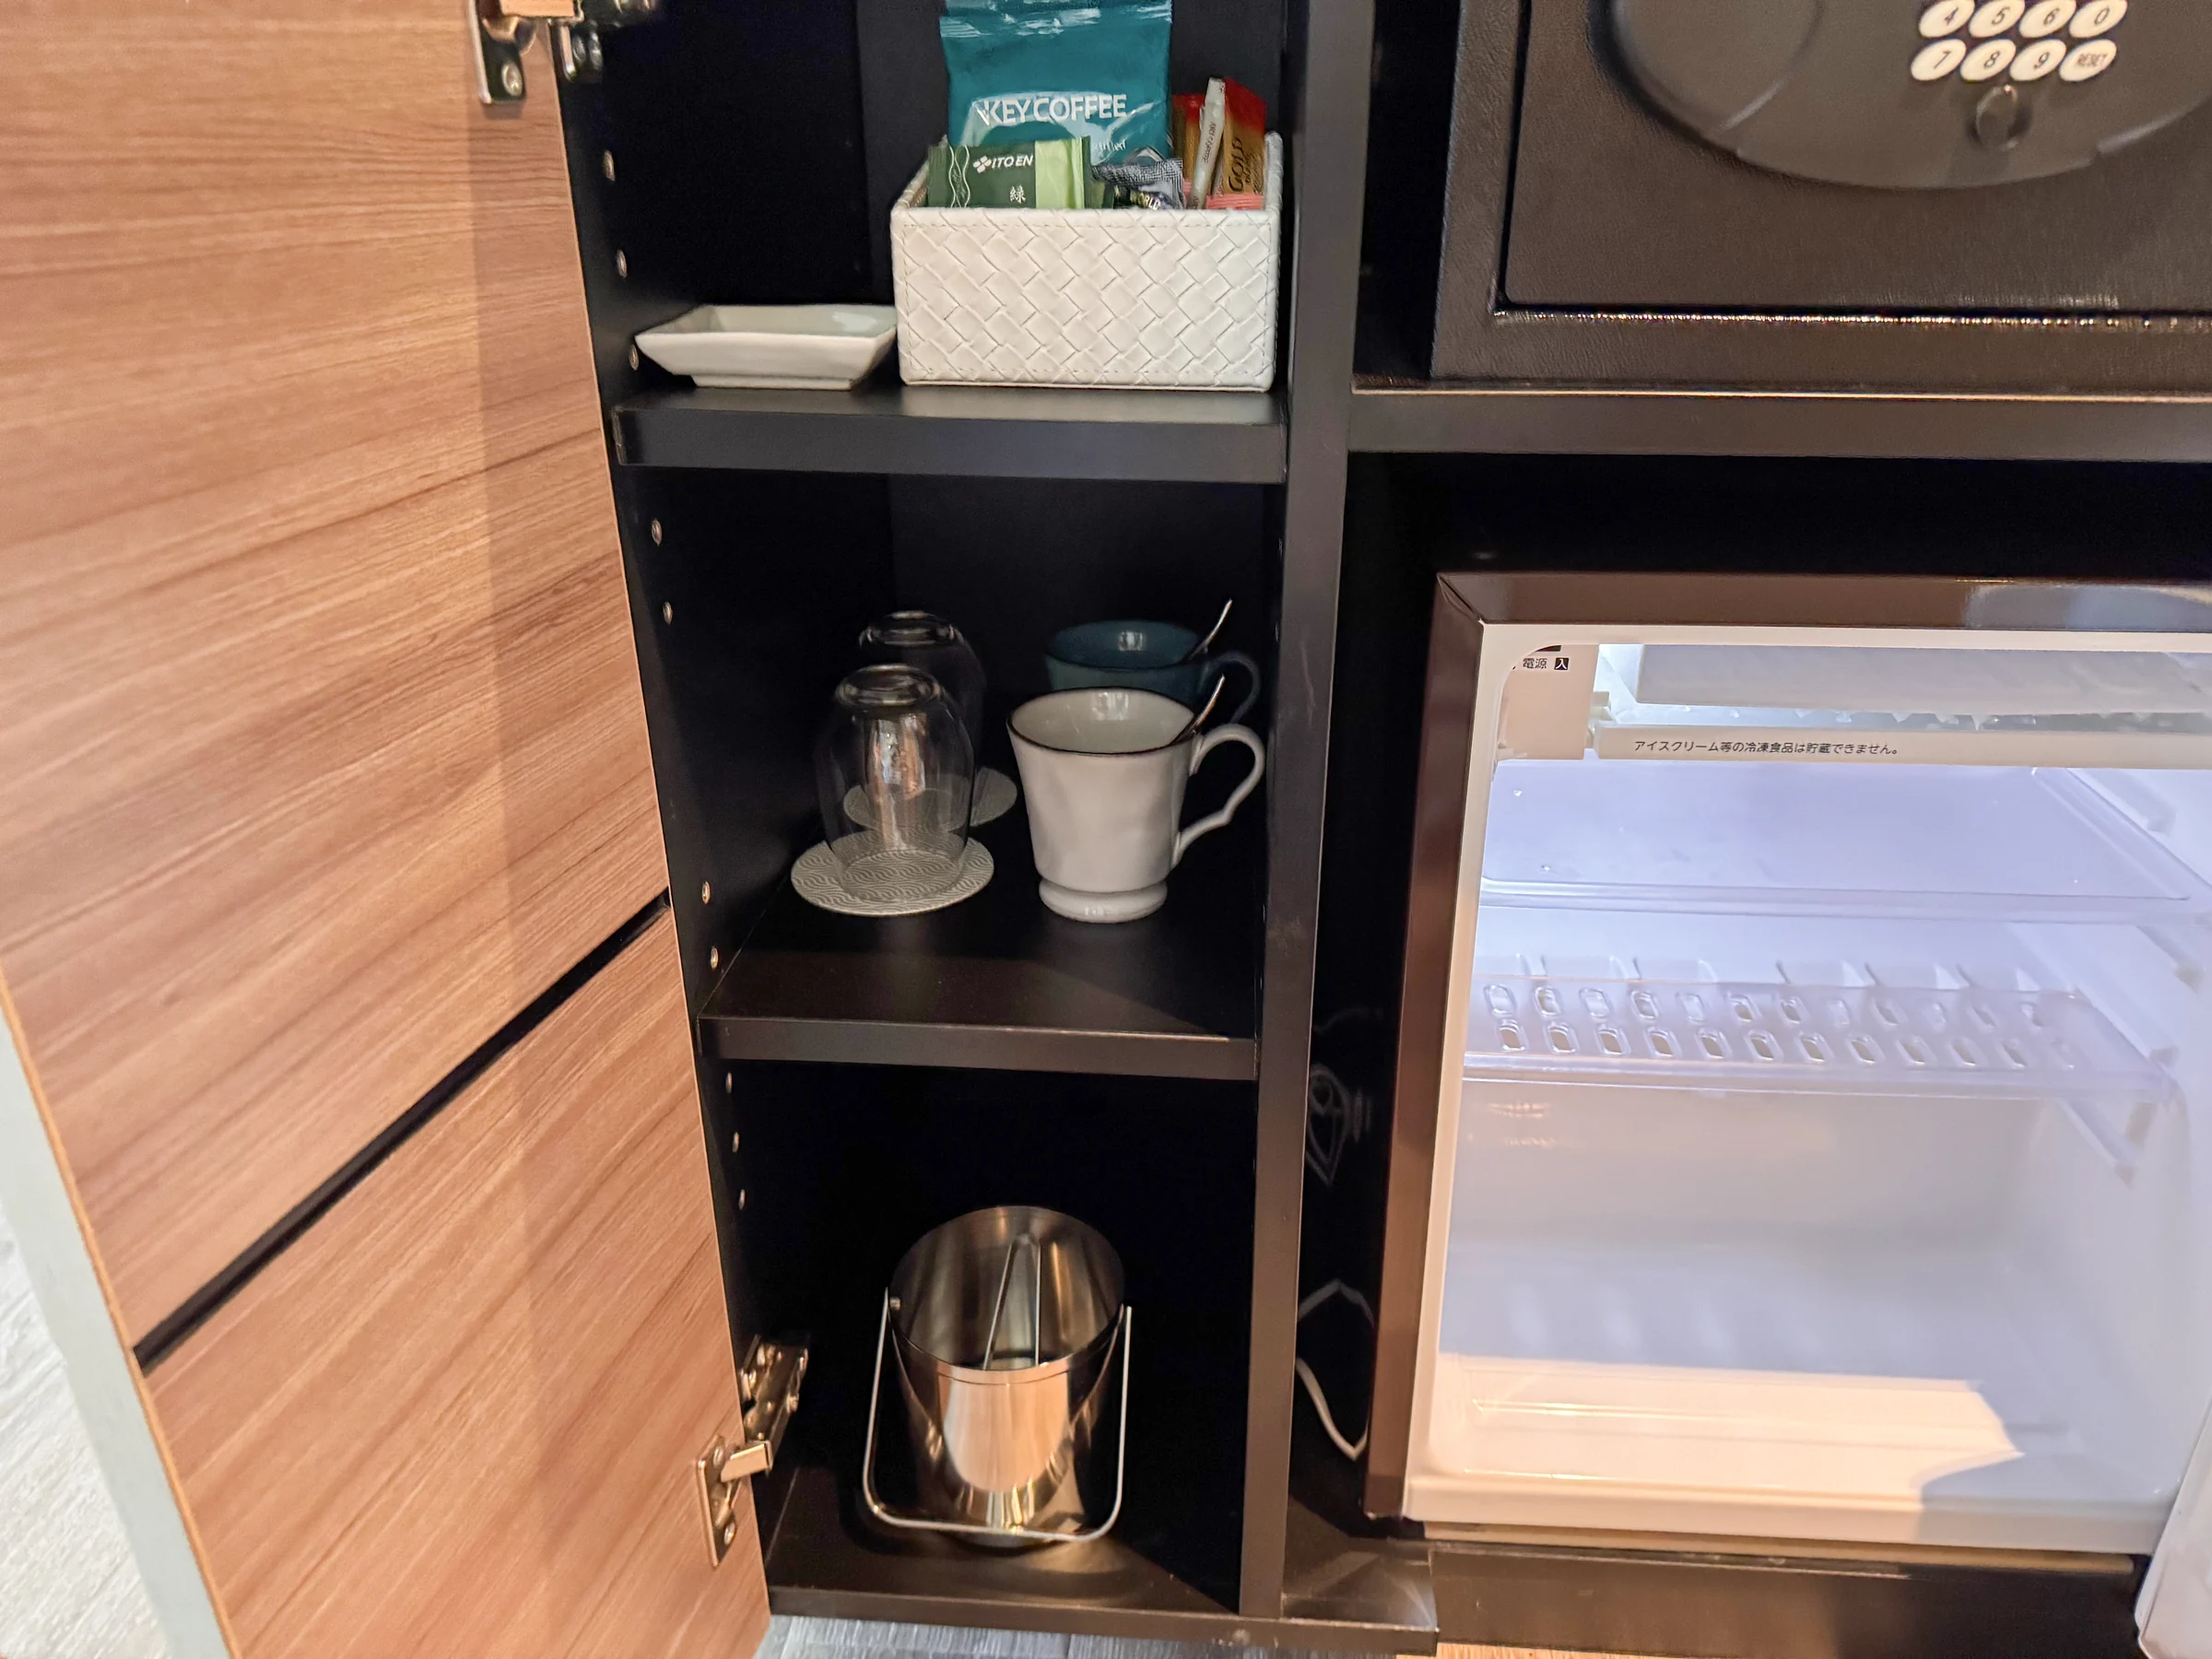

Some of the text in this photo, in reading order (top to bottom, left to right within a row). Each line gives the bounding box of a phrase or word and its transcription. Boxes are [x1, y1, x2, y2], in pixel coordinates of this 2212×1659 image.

[1943, 7, 1959, 26] 4
[1991, 6, 2010, 26] 5
[2042, 7, 2061, 26] 6
[1933, 51, 2109, 70] 7 8 9 RESET
[1228, 137, 1244, 193] GOLD
[1523, 657, 1568, 669] 電源 入
[1634, 740, 1898, 756] アイスクリーム等の冷凍食品は貯蔵できません。
